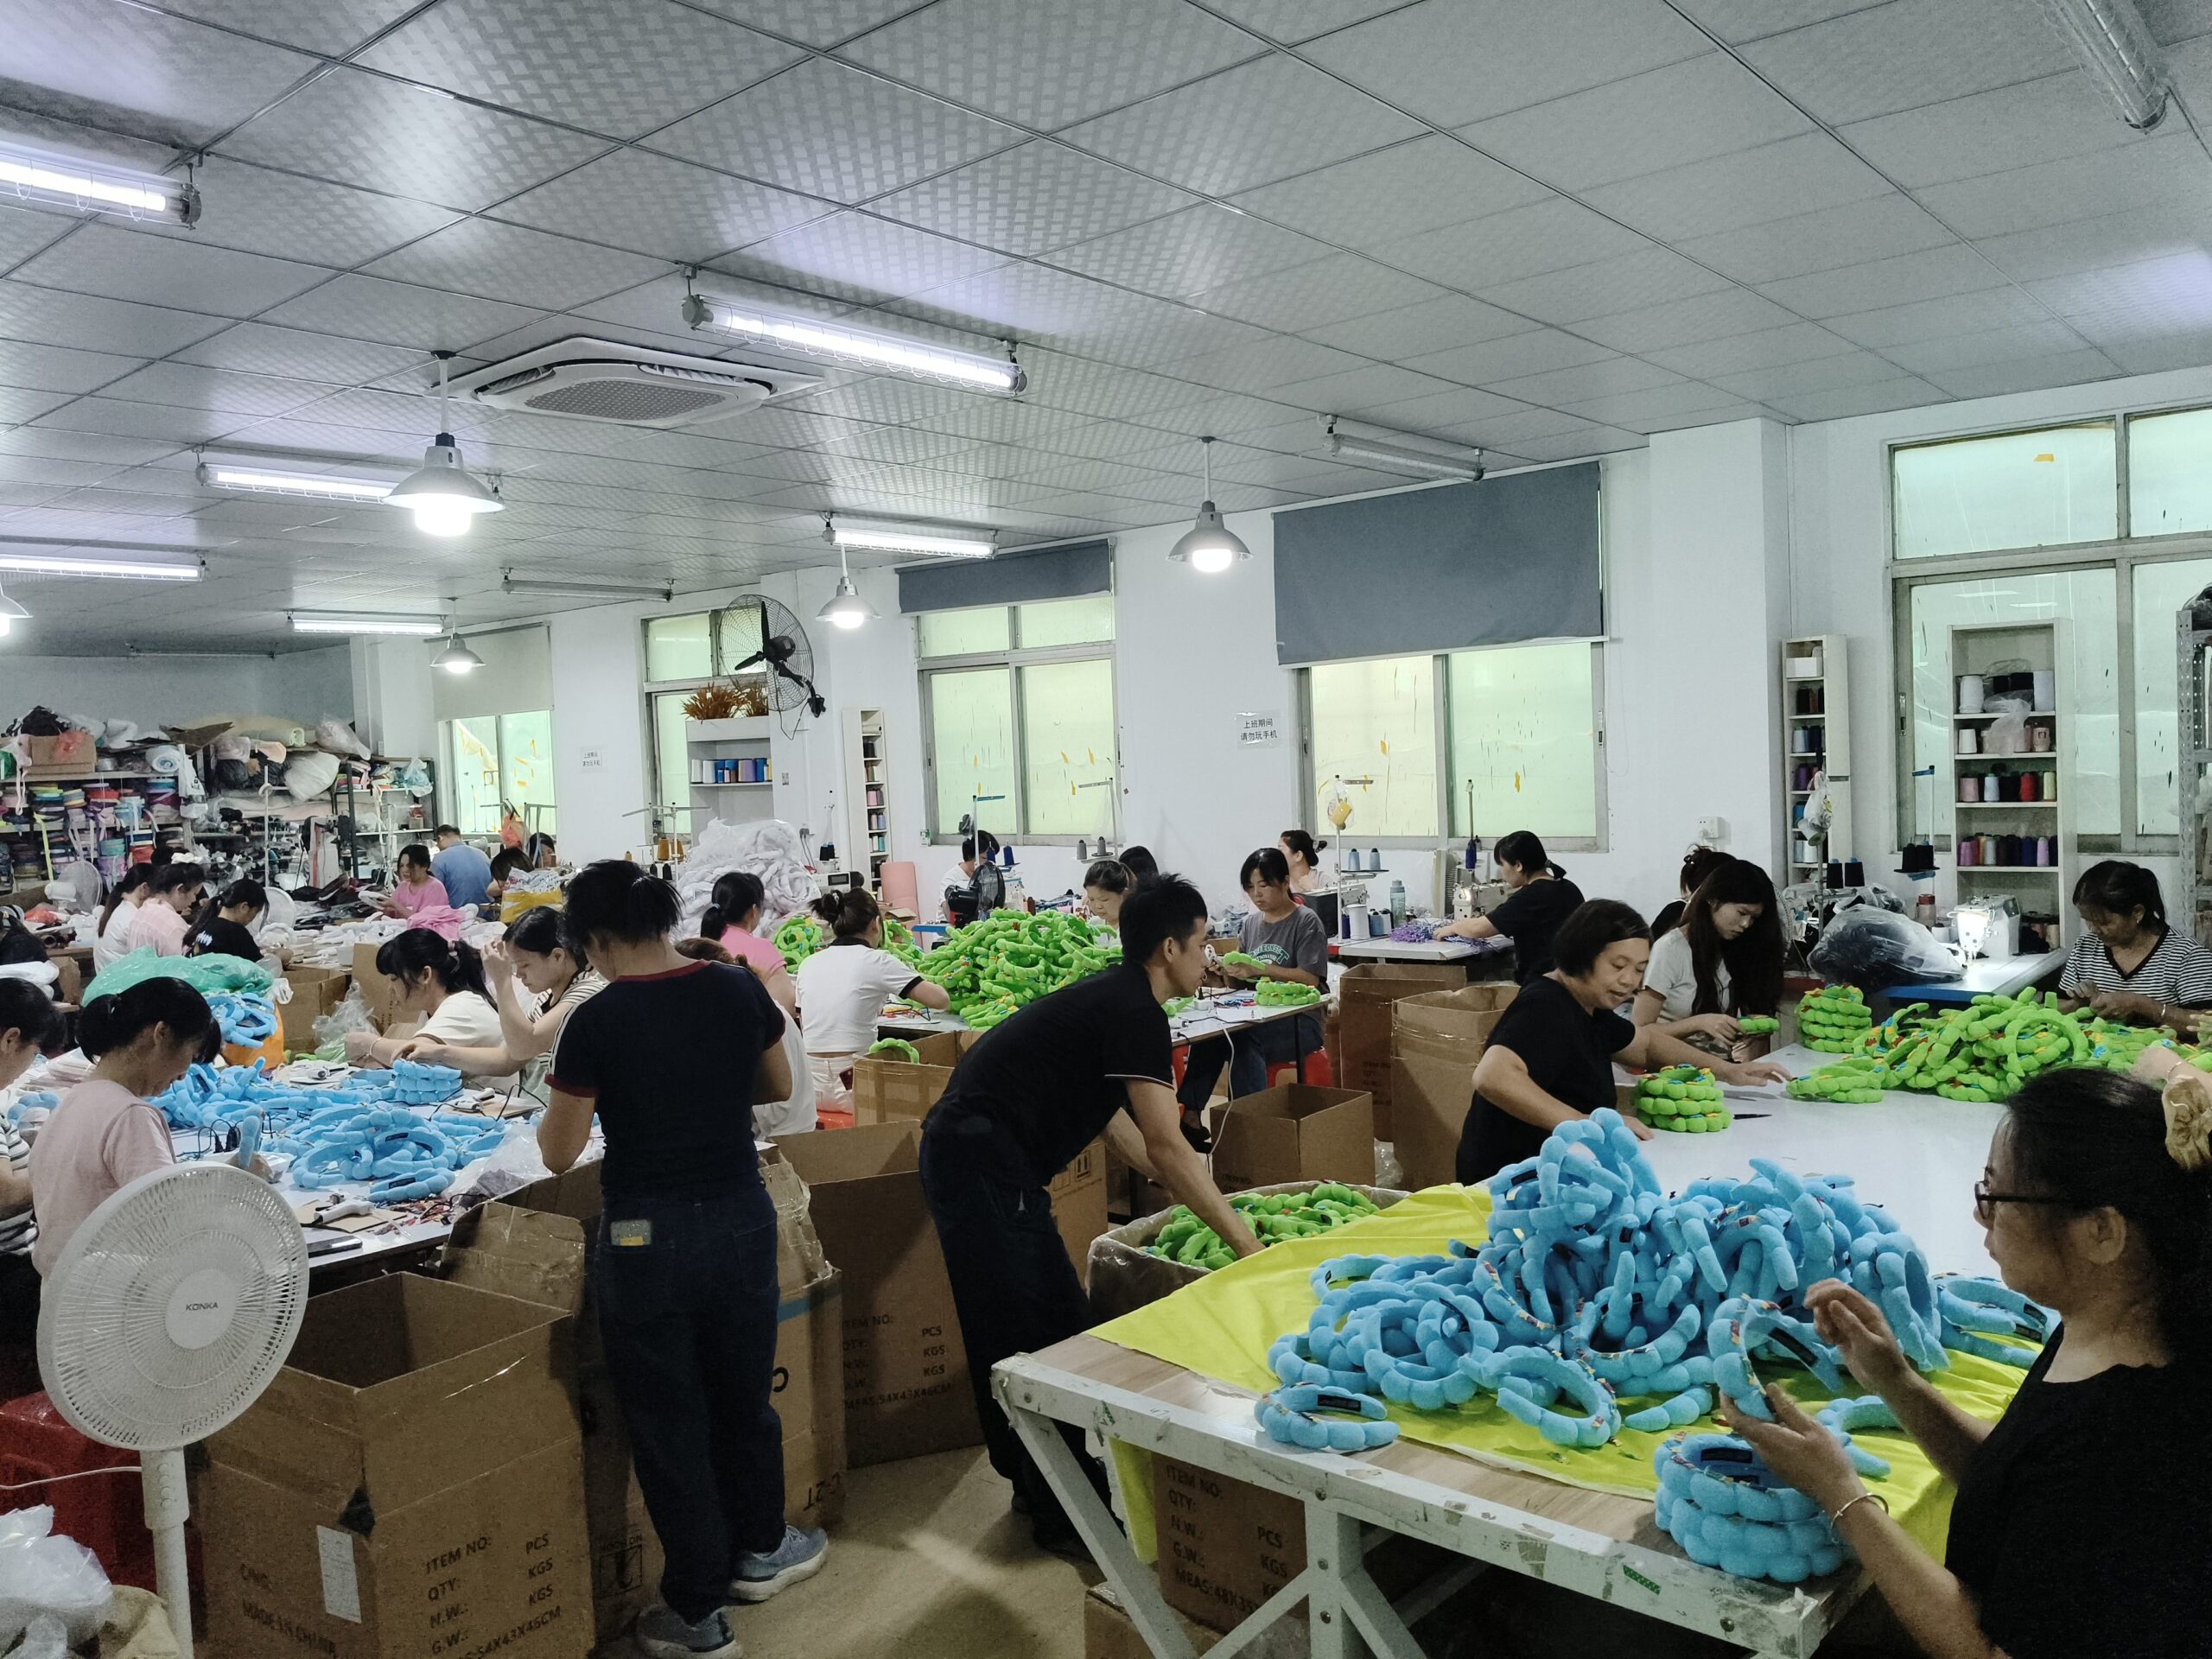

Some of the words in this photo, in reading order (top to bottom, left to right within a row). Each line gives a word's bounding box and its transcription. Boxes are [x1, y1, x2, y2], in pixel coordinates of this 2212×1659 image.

[1244, 718, 1274, 728] 上班期间
[1240, 730, 1277, 741] 请勿玩手机
[186, 1301, 219, 1311] KONKA
[922, 1325, 942, 1338] PCS
[923, 1344, 945, 1357] KGS
[923, 1363, 945, 1377] KGS
[1166, 1465, 1195, 1490] ITEM
[525, 1533, 550, 1554] PCS
[1258, 1525, 1282, 1549] PCS
[426, 1547, 462, 1574] ITEM
[528, 1557, 554, 1580] KGS
[1261, 1554, 1288, 1579] KGS
[529, 1583, 554, 1605] KGS
